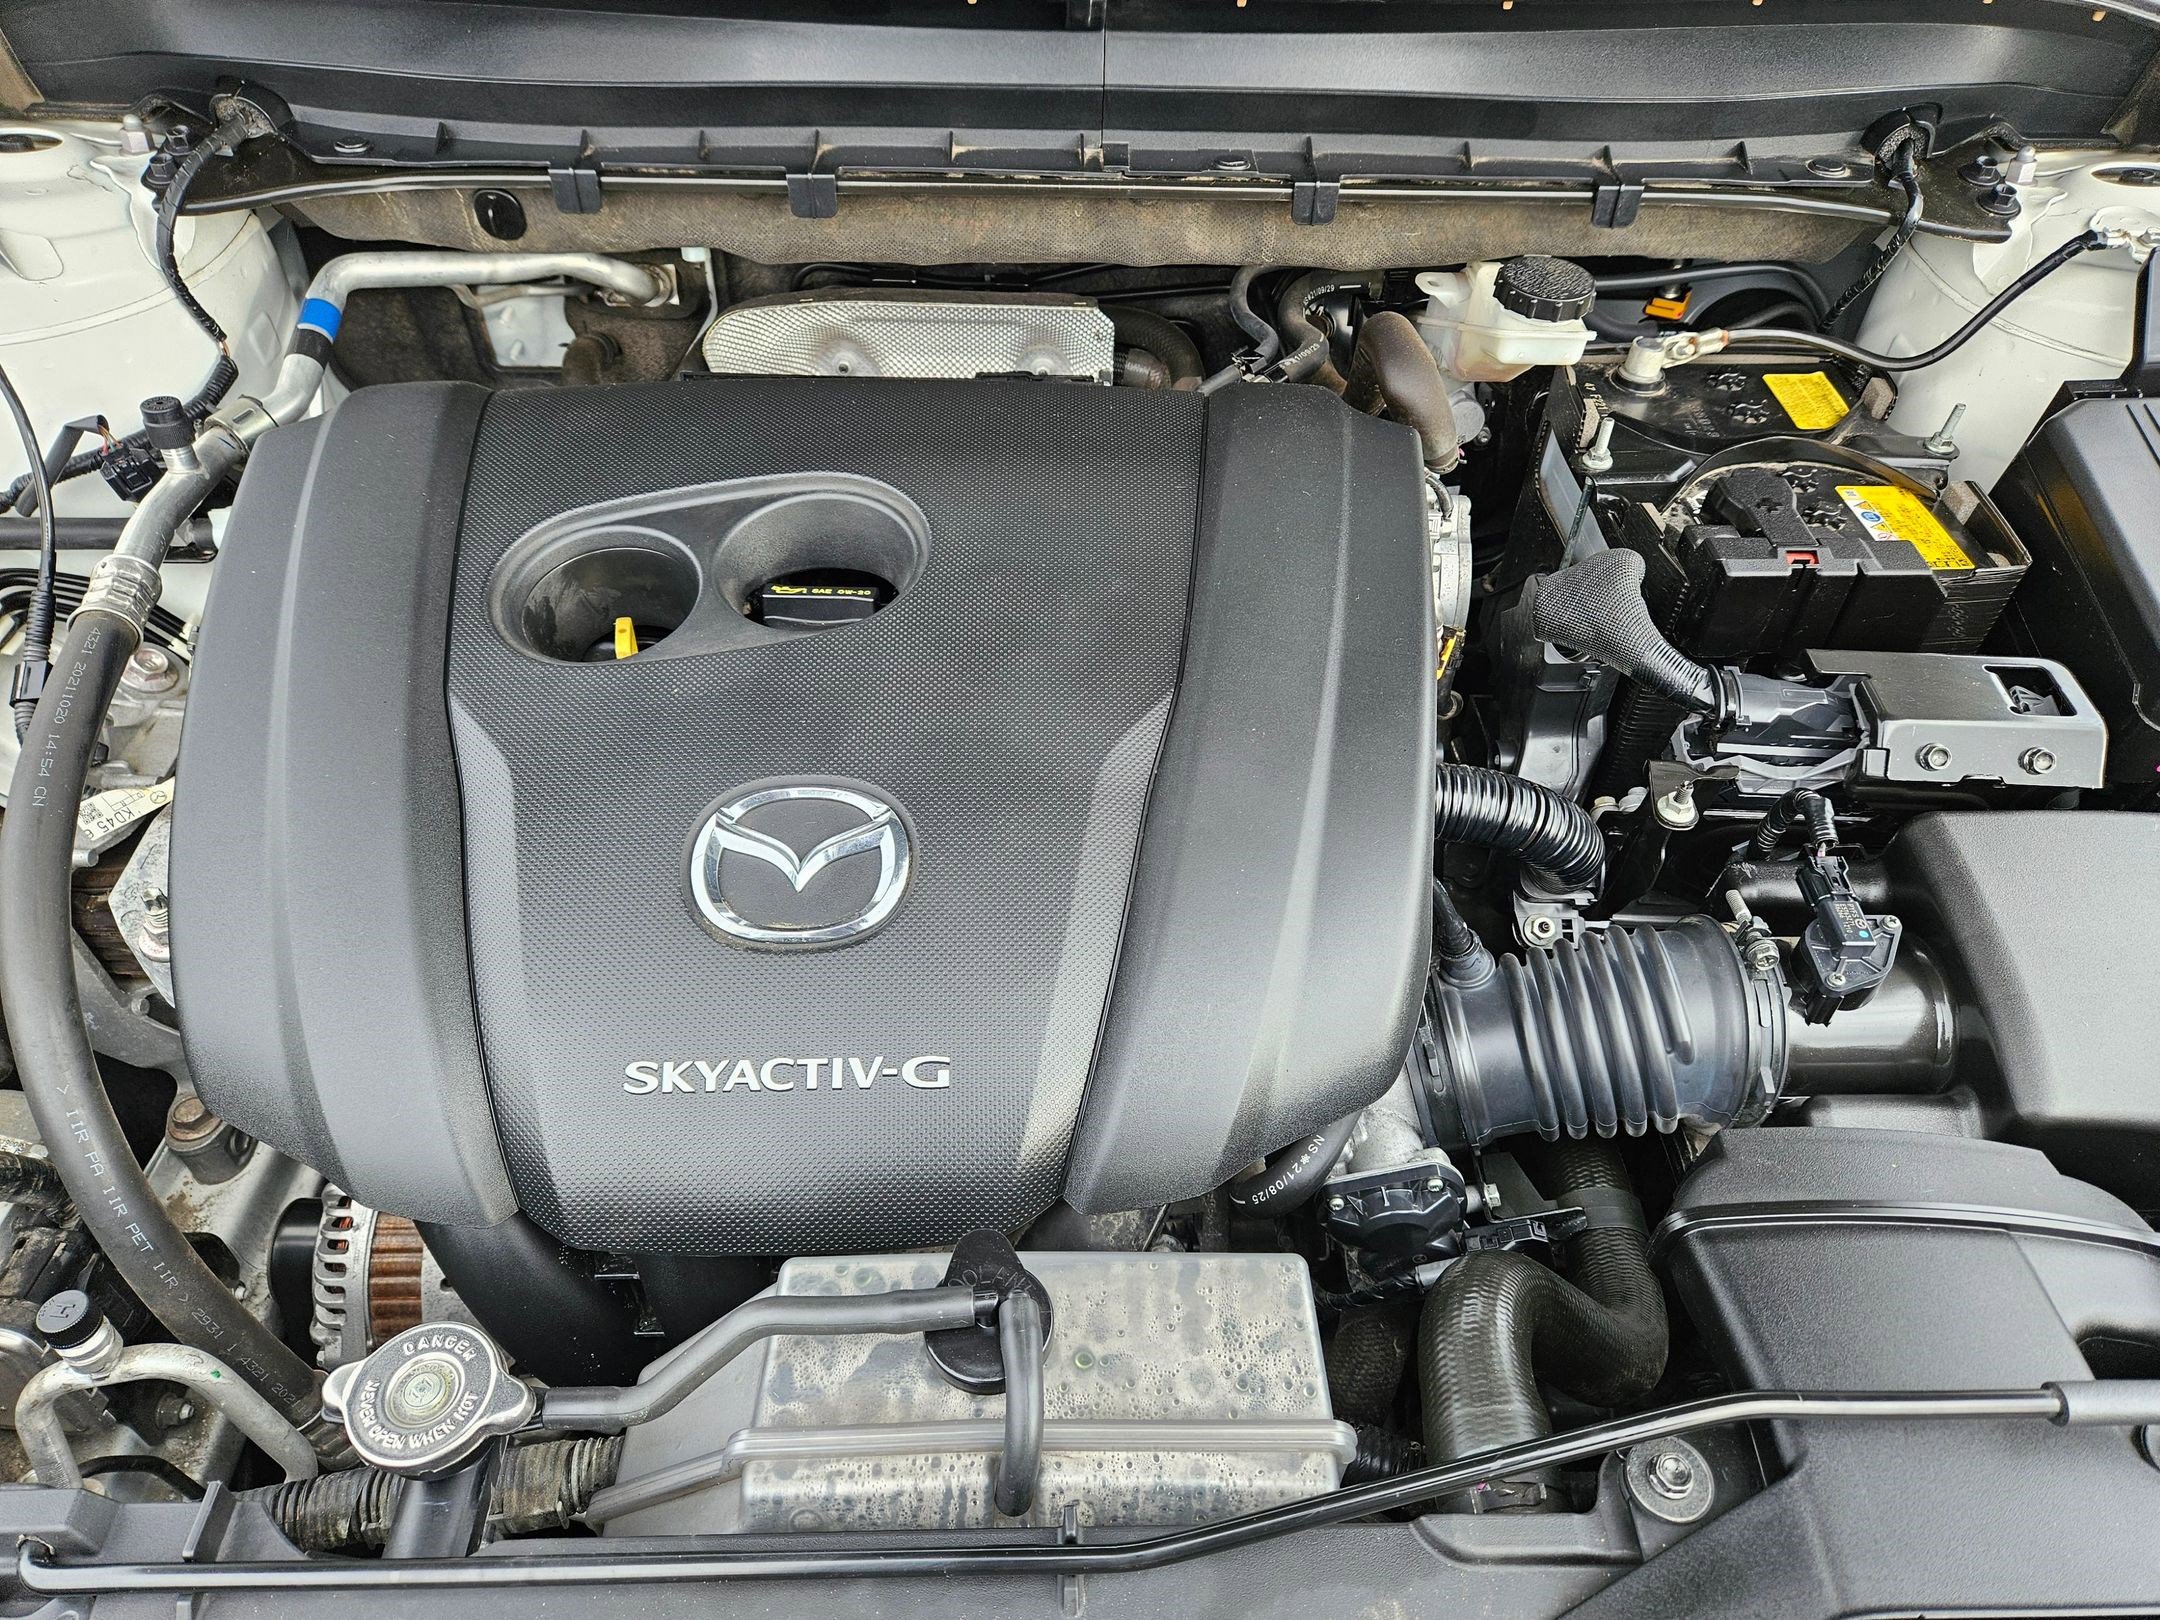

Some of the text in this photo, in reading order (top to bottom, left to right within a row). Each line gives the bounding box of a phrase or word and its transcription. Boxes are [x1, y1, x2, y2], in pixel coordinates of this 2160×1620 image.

[32, 627, 101, 807] 4321 20211020 14:54 CN
[96, 806, 135, 833] KD45
[622, 1055, 952, 1095] SKYACTIV-G
[84, 1151, 105, 1177] PA
[125, 1223, 154, 1253] PET
[402, 1334, 477, 1362] DANGER
[359, 1378, 480, 1450] NEVER OPEN WHEN HOT
